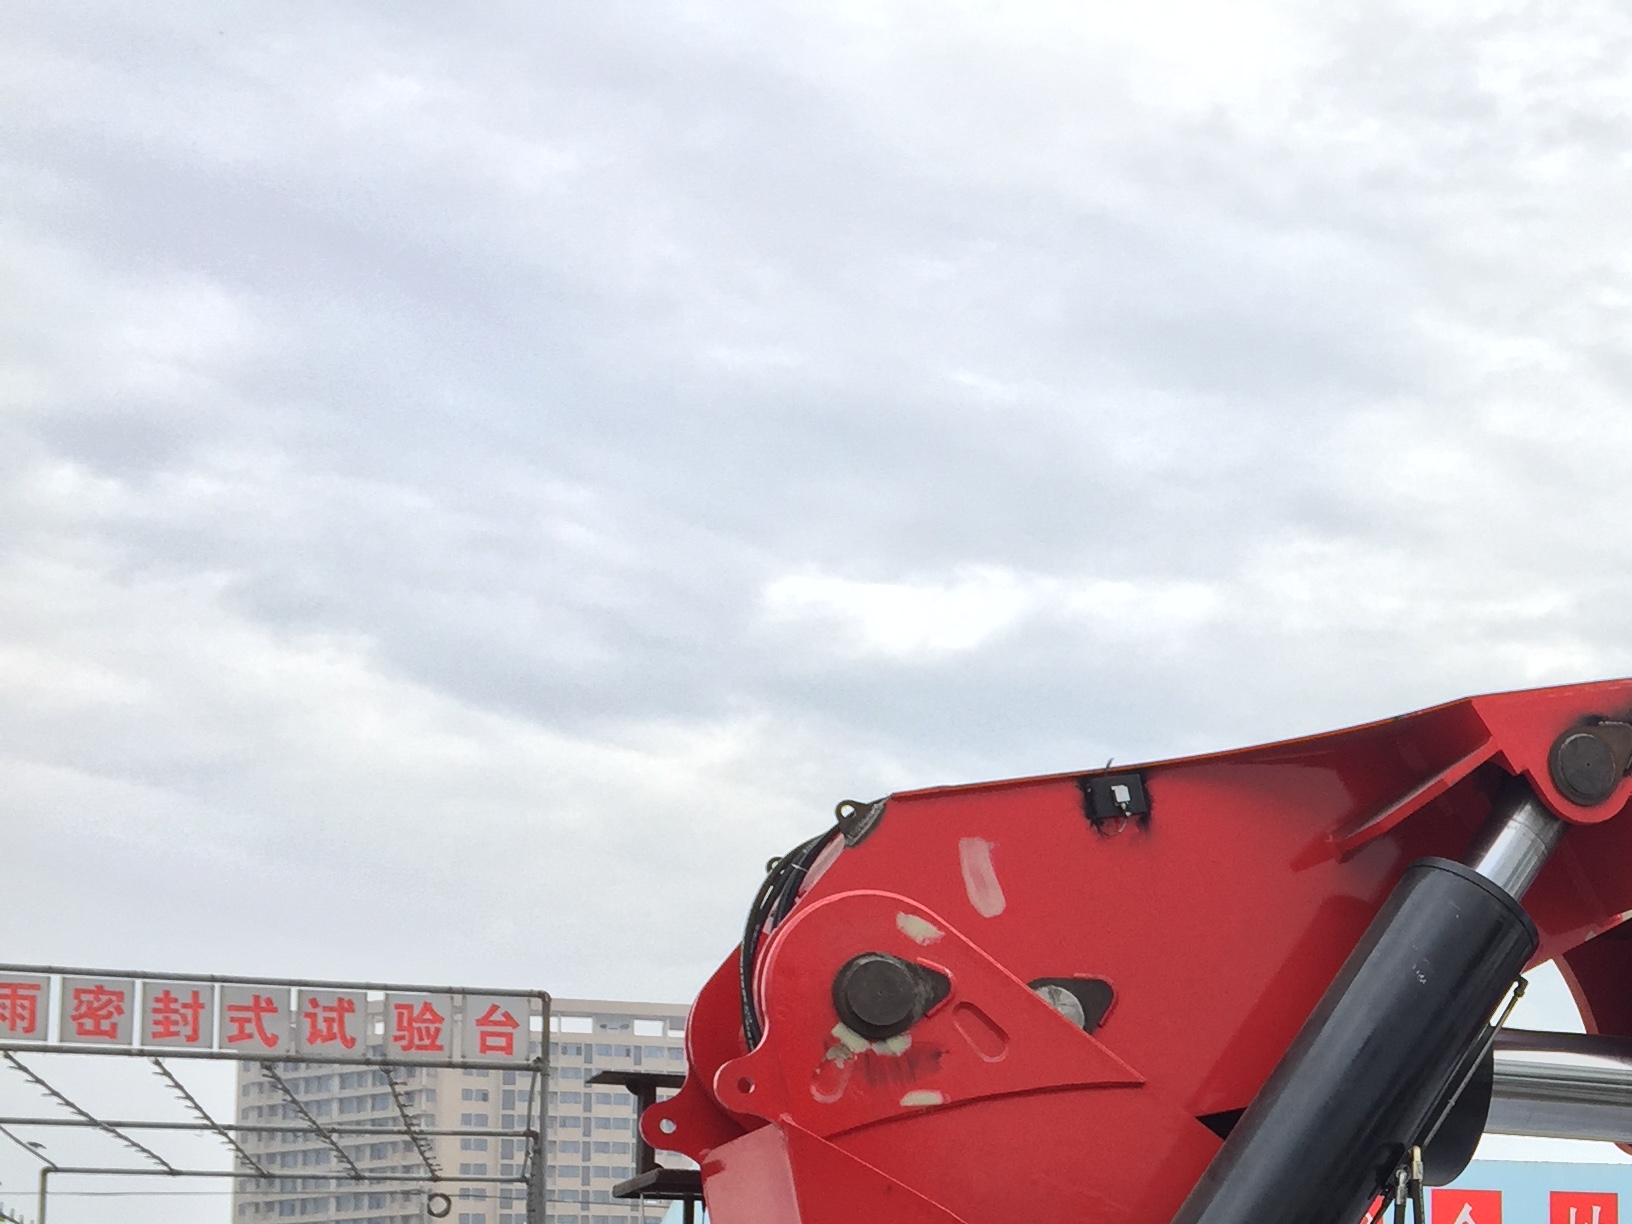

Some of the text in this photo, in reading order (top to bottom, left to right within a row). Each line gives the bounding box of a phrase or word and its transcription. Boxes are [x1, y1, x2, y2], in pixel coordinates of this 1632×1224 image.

[0, 981, 521, 1056] 雨密封式试验台
